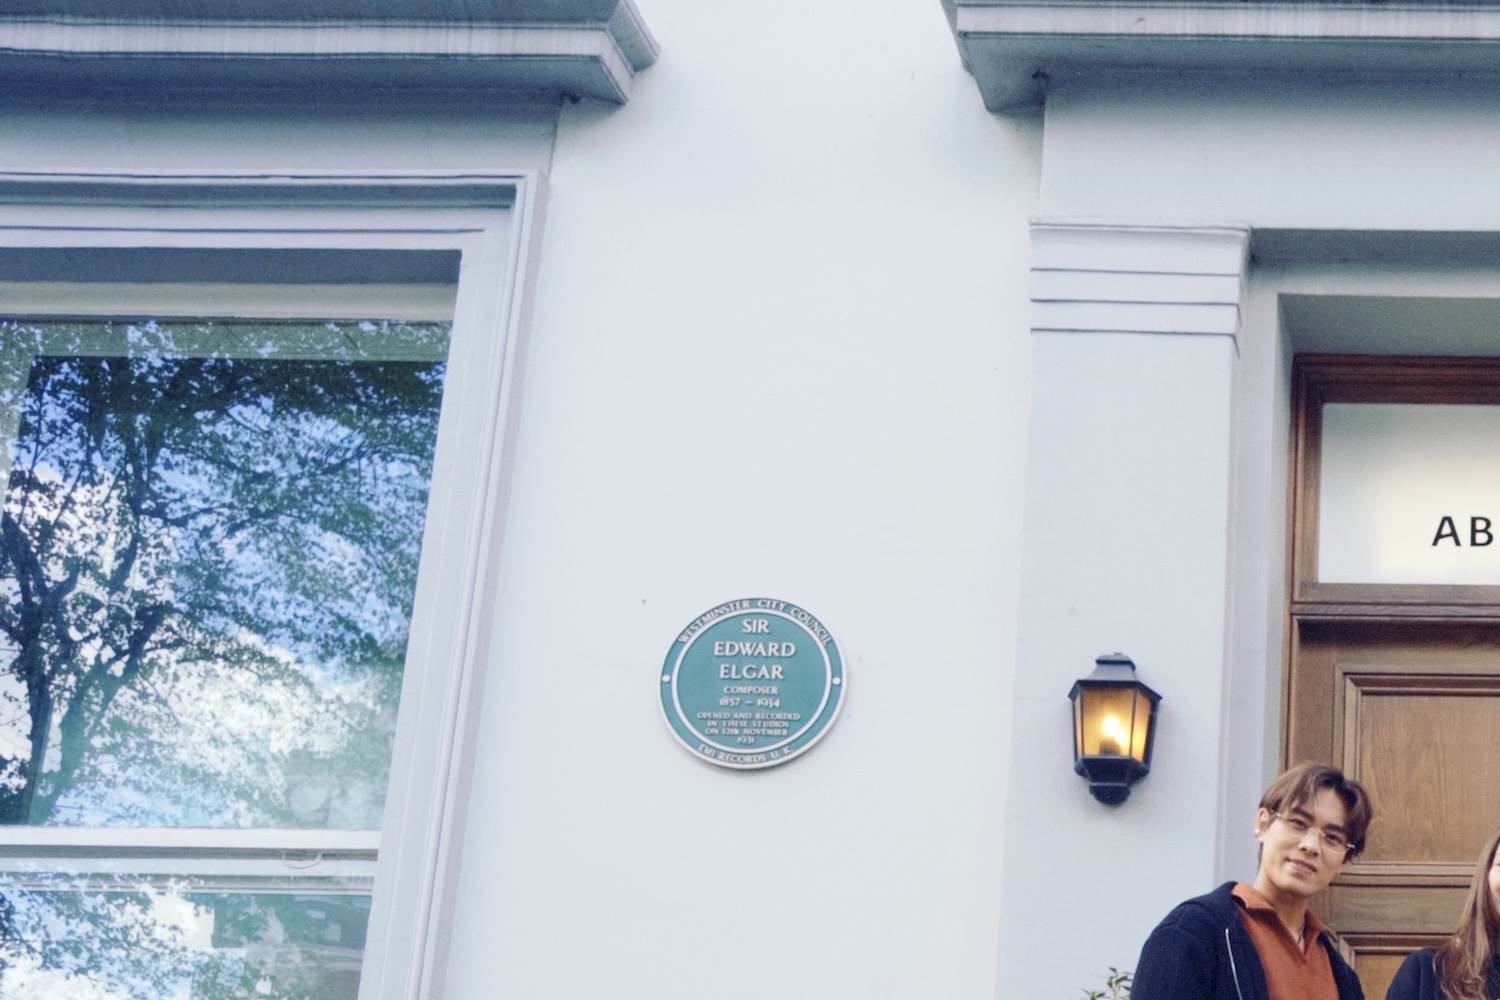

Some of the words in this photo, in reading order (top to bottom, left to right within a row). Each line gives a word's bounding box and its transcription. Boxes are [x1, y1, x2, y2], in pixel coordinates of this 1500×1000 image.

[677, 600, 750, 644] WESTMINSTER
[757, 599, 787, 612] CITY
[790, 607, 832, 647] COUNCIL
[742, 619, 769, 633] SIR
[713, 641, 796, 657] EDWARD
[719, 664, 784, 680] ELGAR
[723, 685, 778, 695] COMPOSER
[719, 696, 740, 707] 1857
[718, 752, 766, 763] RECORDS
